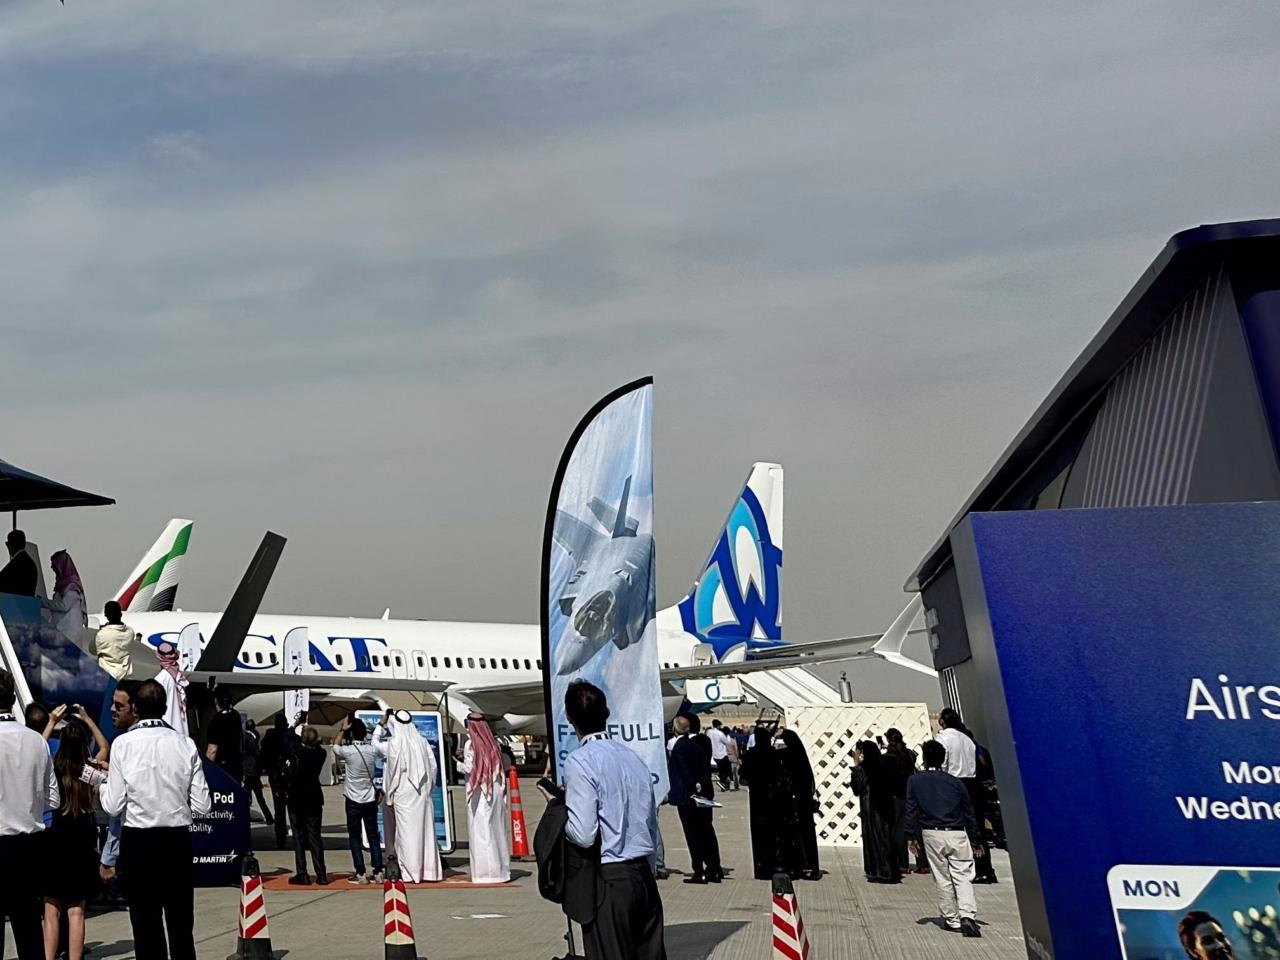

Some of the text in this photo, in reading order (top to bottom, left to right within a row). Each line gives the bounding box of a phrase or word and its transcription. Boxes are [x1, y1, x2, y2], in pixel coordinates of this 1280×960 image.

[607, 722, 661, 743] FULL
[213, 792, 234, 804] Pod
[1122, 880, 1181, 897] MON
